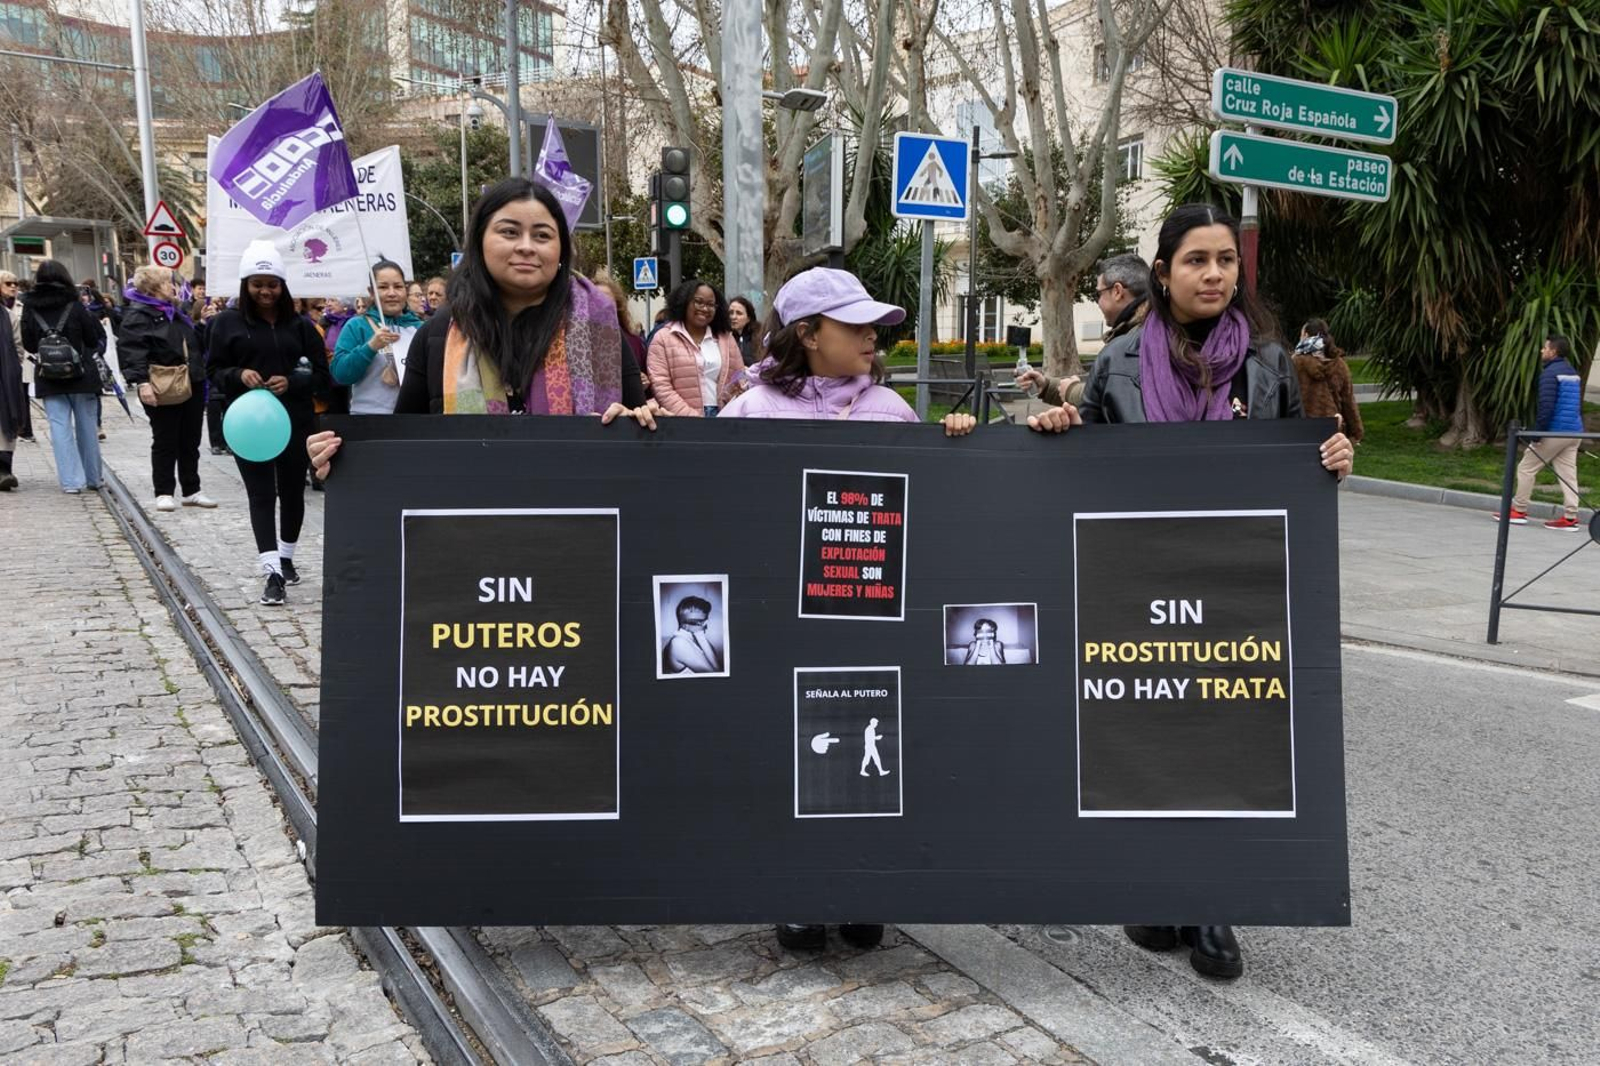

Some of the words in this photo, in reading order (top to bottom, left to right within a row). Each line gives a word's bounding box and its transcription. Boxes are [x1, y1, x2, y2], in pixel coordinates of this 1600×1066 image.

[1226, 78, 1261, 95] calle
[1225, 93, 1256, 113] Cruz
[1262, 99, 1293, 121] Roja
[1298, 105, 1357, 129] Española
[358, 166, 376, 184] DE
[1347, 159, 1386, 176] paseo
[1288, 165, 1305, 182] de
[1310, 168, 1323, 185] la
[1329, 171, 1385, 193] Estación
[160, 250, 177, 262] 30
[827, 491, 838, 504] EL
[871, 493, 884, 506] DE
[807, 506, 854, 523] VÍCTIMAS
[857, 511, 869, 524] DE
[872, 512, 902, 525] TRATA
[822, 528, 842, 541] CON
[844, 529, 871, 543] FINES
[873, 530, 886, 543] DE
[821, 546, 886, 561] EXPLOTACIÓN
[823, 565, 859, 579] SEXUAL
[862, 566, 882, 580] SON
[478, 577, 532, 602] SIN
[807, 583, 853, 597] MUJERES
[856, 585, 862, 598] Y
[865, 583, 894, 598] NIÑAS
[1150, 600, 1203, 624] SIN
[432, 622, 581, 649] PUTEROS
[1085, 636, 1281, 663] PROSTITUCIÓN
[456, 666, 499, 689] NO
[508, 666, 565, 688] HAY
[805, 688, 839, 698] SEÑALA
[840, 690, 852, 698] AL
[854, 689, 888, 698] PUTERO
[1083, 678, 1125, 700] NO
[1134, 678, 1190, 700] HAY
[1196, 678, 1286, 699] TRATA
[406, 698, 612, 727] PROSTITUCIÓN
